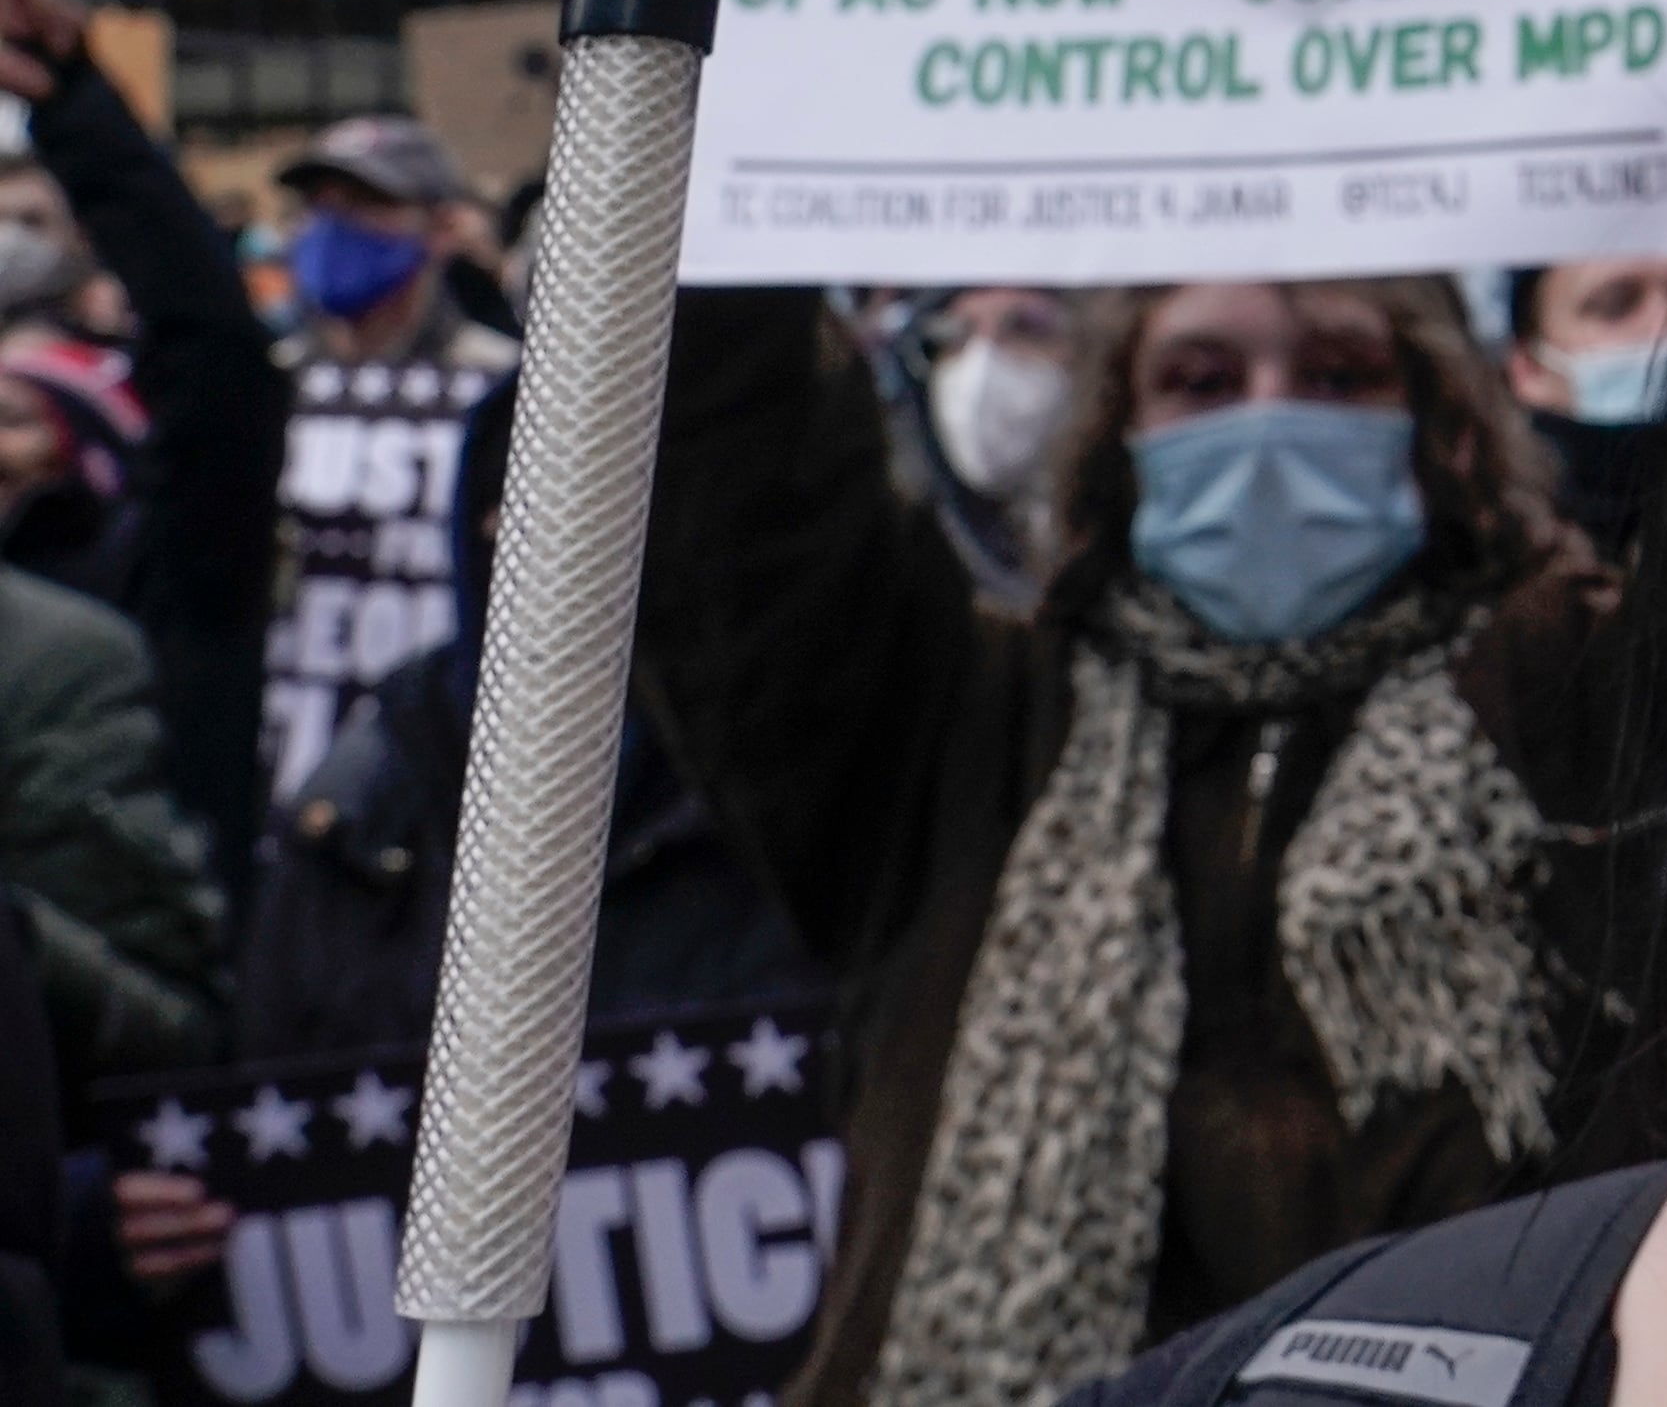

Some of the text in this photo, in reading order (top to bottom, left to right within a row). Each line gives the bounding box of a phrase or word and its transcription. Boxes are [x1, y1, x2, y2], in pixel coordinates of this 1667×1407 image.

[915, 5, 1667, 108] CONTROL OVER MPD
[193, 1138, 847, 1402] JUTIC
[1280, 1331, 1416, 1374] PUMA
